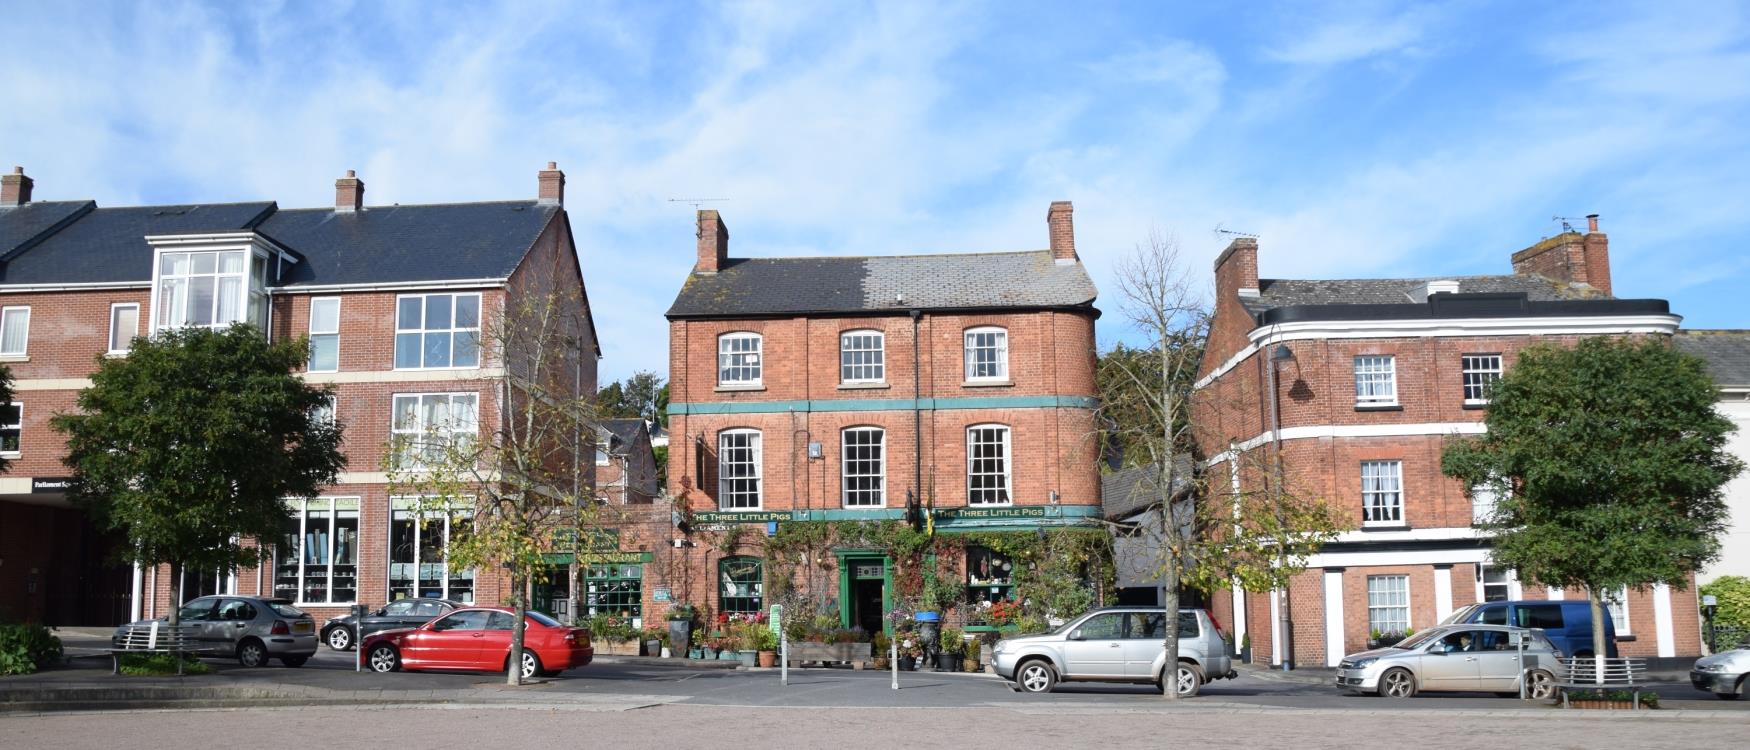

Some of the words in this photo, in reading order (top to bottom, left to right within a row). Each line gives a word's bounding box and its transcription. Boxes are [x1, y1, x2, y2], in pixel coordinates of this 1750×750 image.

[709, 513, 738, 521] THREE
[740, 513, 768, 521] LITTLE
[770, 512, 791, 520] PIGS
[938, 510, 957, 518] THE
[959, 509, 988, 517] THREE
[990, 509, 1021, 517] LITTLE
[1022, 508, 1044, 516] PIGS
